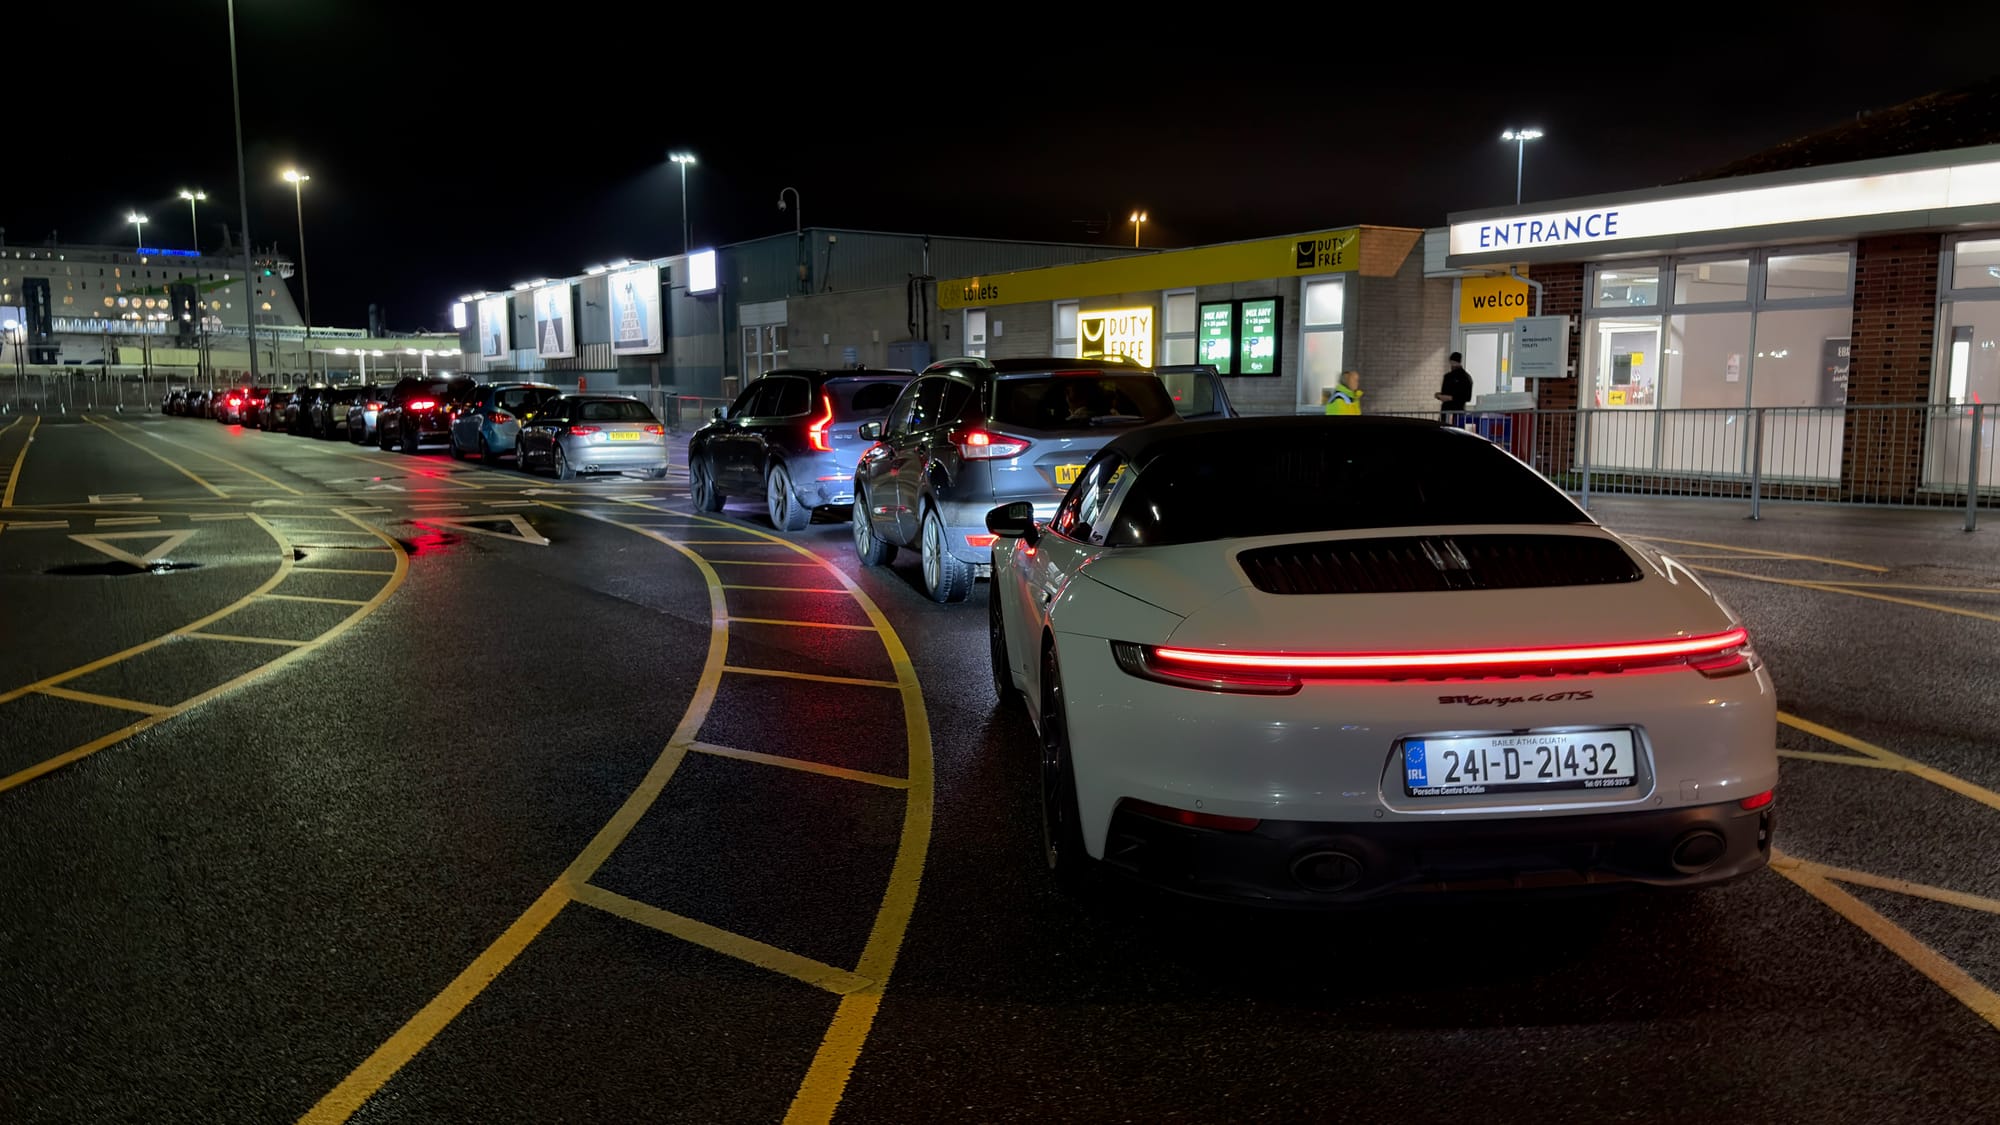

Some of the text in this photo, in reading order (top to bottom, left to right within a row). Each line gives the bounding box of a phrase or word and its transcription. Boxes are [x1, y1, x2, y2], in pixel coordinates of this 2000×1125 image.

[1480, 212, 1619, 248] ENTRANCE
[1318, 237, 1345, 252] DUTY
[1318, 252, 1342, 266] FREE
[963, 283, 998, 301] toilets
[1473, 291, 1525, 309] welco
[1109, 316, 1148, 337] DUTY
[1111, 340, 1144, 361] FREE
[1545, 690, 1594, 702] GTS
[1538, 736, 1567, 745] CLIATH
[1443, 742, 1618, 784] 241-D-21432
[1408, 769, 1426, 780] IRL
[1413, 788, 1440, 796] Porsche
